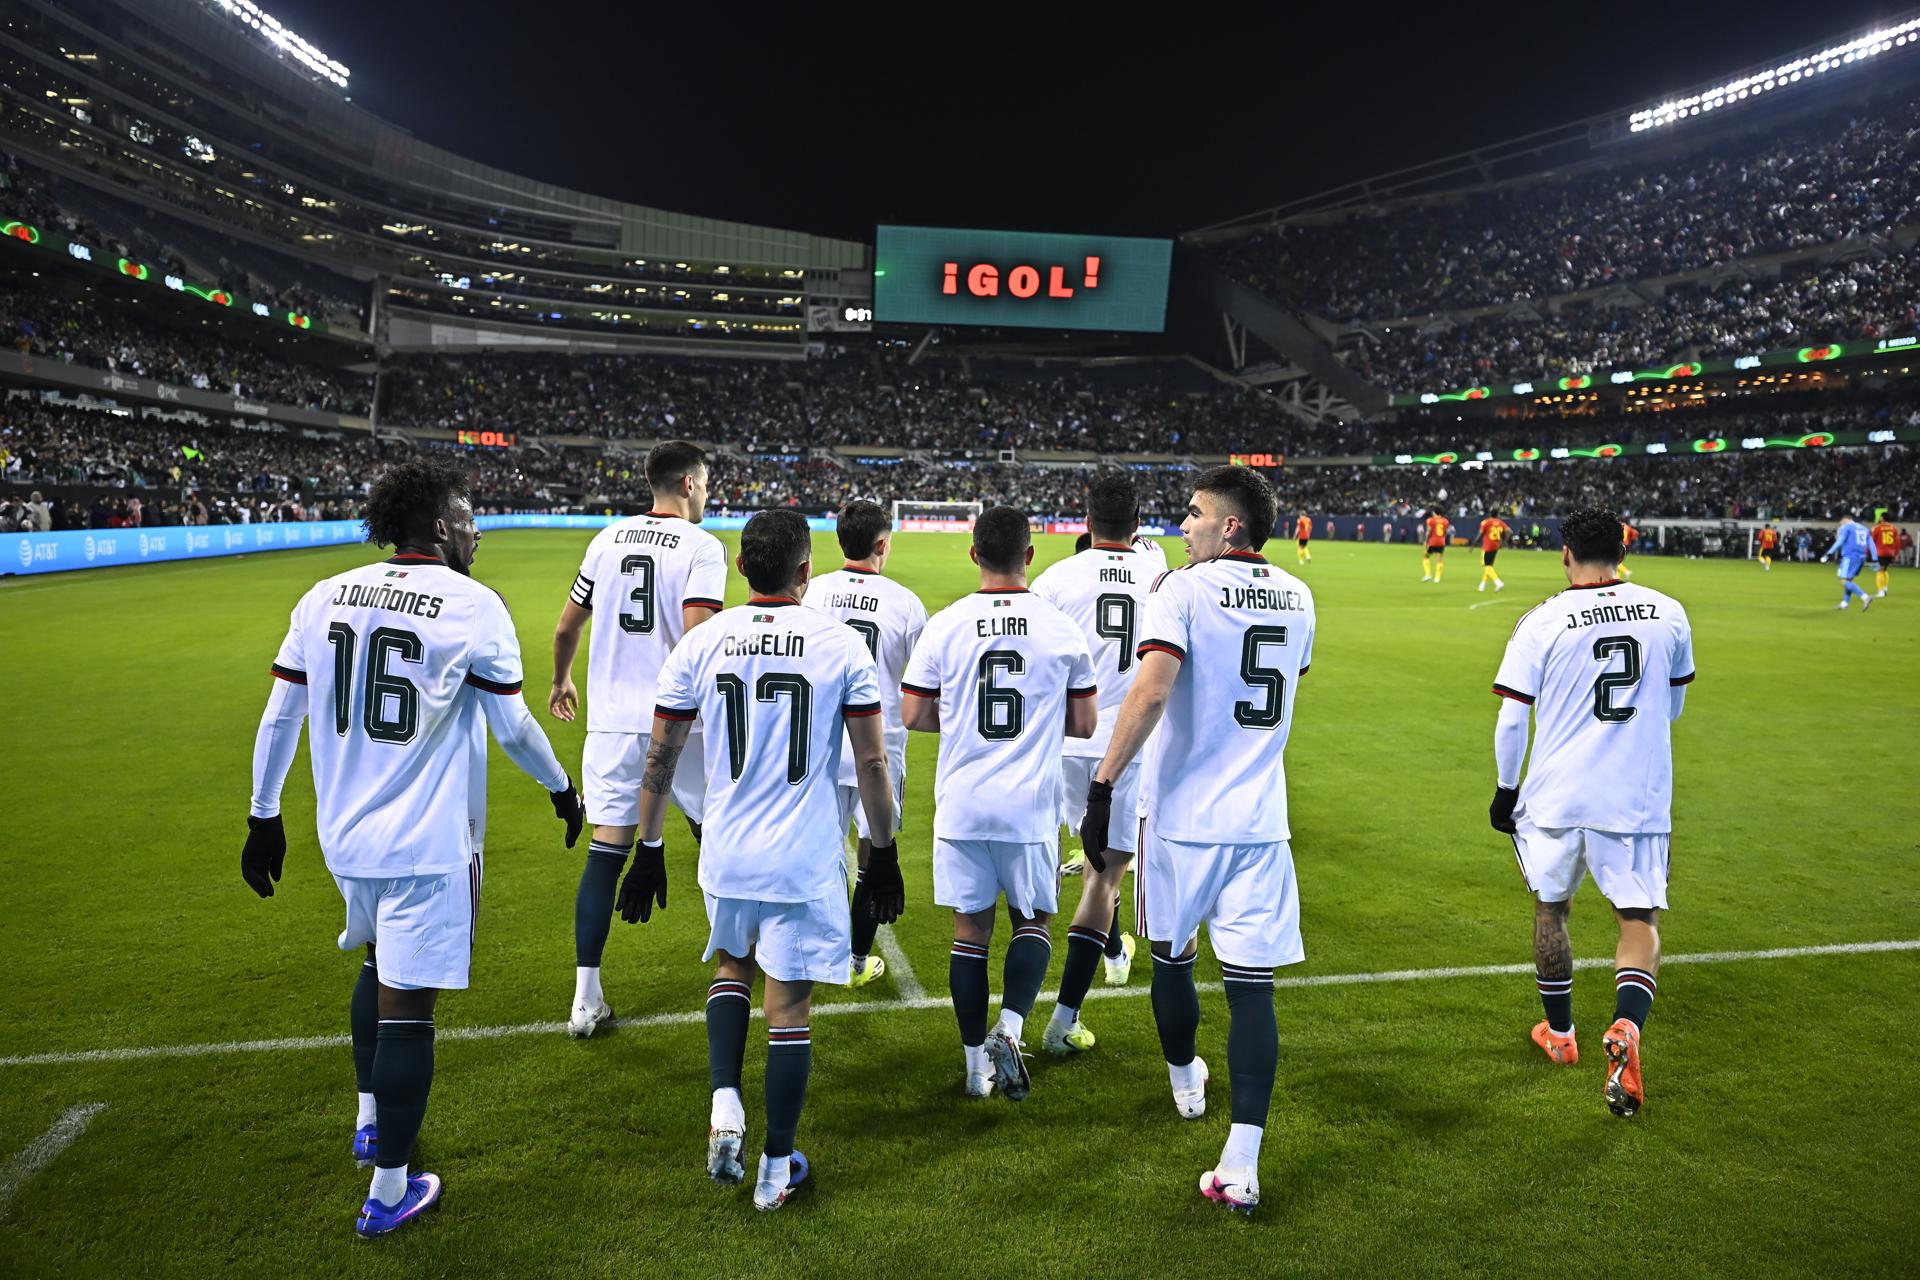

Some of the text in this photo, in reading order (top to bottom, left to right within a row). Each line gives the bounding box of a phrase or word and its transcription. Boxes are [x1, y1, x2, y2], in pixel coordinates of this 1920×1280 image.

[614, 529, 681, 549] C.MONTES
[1436, 523, 1444, 537] 6
[1856, 530, 1867, 546] 13
[1882, 531, 1894, 545] 16
[34, 542, 58, 561] AT&T
[96, 539, 117, 556] AT&T
[149, 536, 166, 551] AT&T
[1099, 566, 1136, 585] RAÚL
[332, 583, 444, 619] J.QUIÑONES
[619, 554, 655, 635] 3
[1220, 584, 1305, 611] J.VÁSQUEZ
[976, 617, 1028, 638] E.LIRA
[1567, 604, 1660, 629] J.SÁNCHEZ
[725, 631, 805, 658] ORBELÍN
[1095, 593, 1137, 674] 9
[328, 621, 424, 746] 16
[1233, 625, 1288, 730] 5
[1593, 635, 1643, 724] 2
[978, 650, 1026, 742] 6
[716, 672, 814, 785] 17
